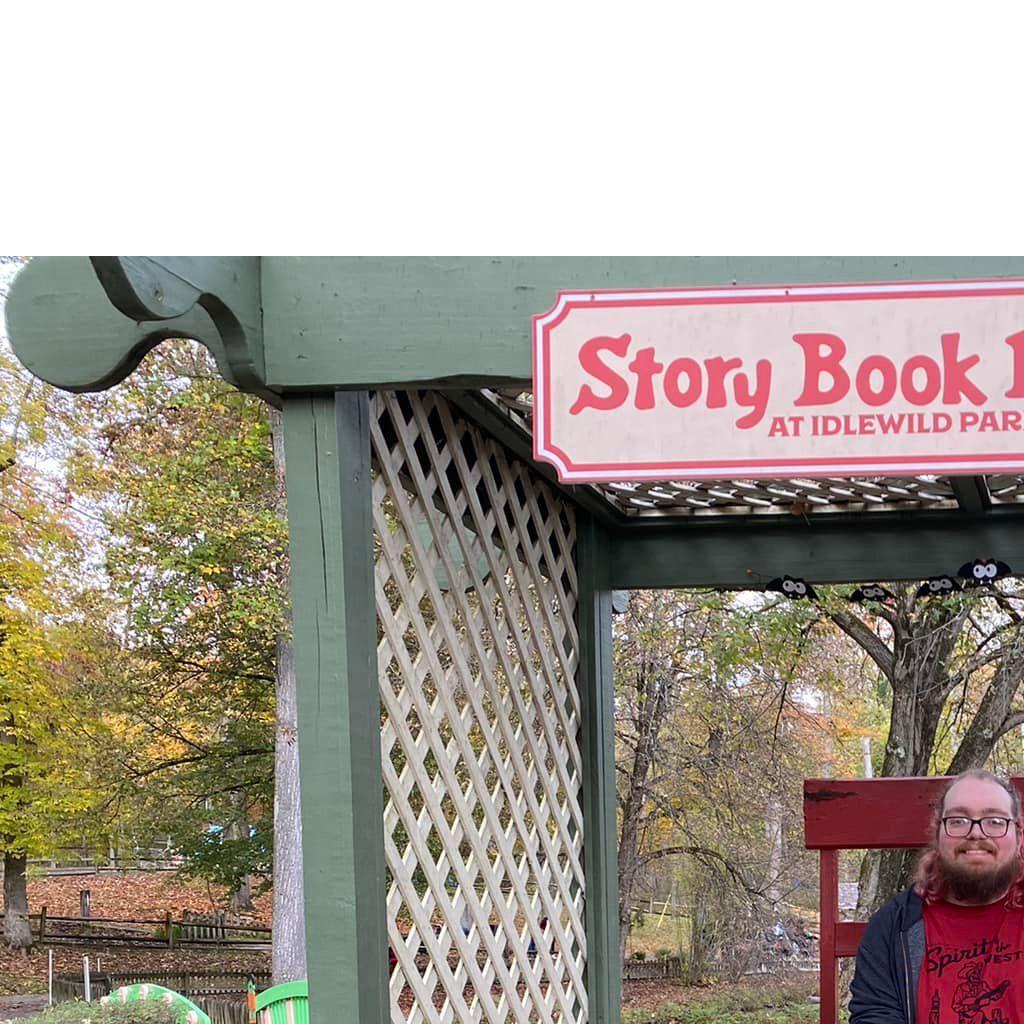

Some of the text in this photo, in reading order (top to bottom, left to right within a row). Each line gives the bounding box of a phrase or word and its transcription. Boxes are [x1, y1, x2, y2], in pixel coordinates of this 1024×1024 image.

[569, 333, 772, 431] Story
[792, 333, 988, 409] Book
[769, 416, 803, 438] AT
[811, 413, 953, 437] IDLEWILD
[926, 939, 989, 977] Spirit
